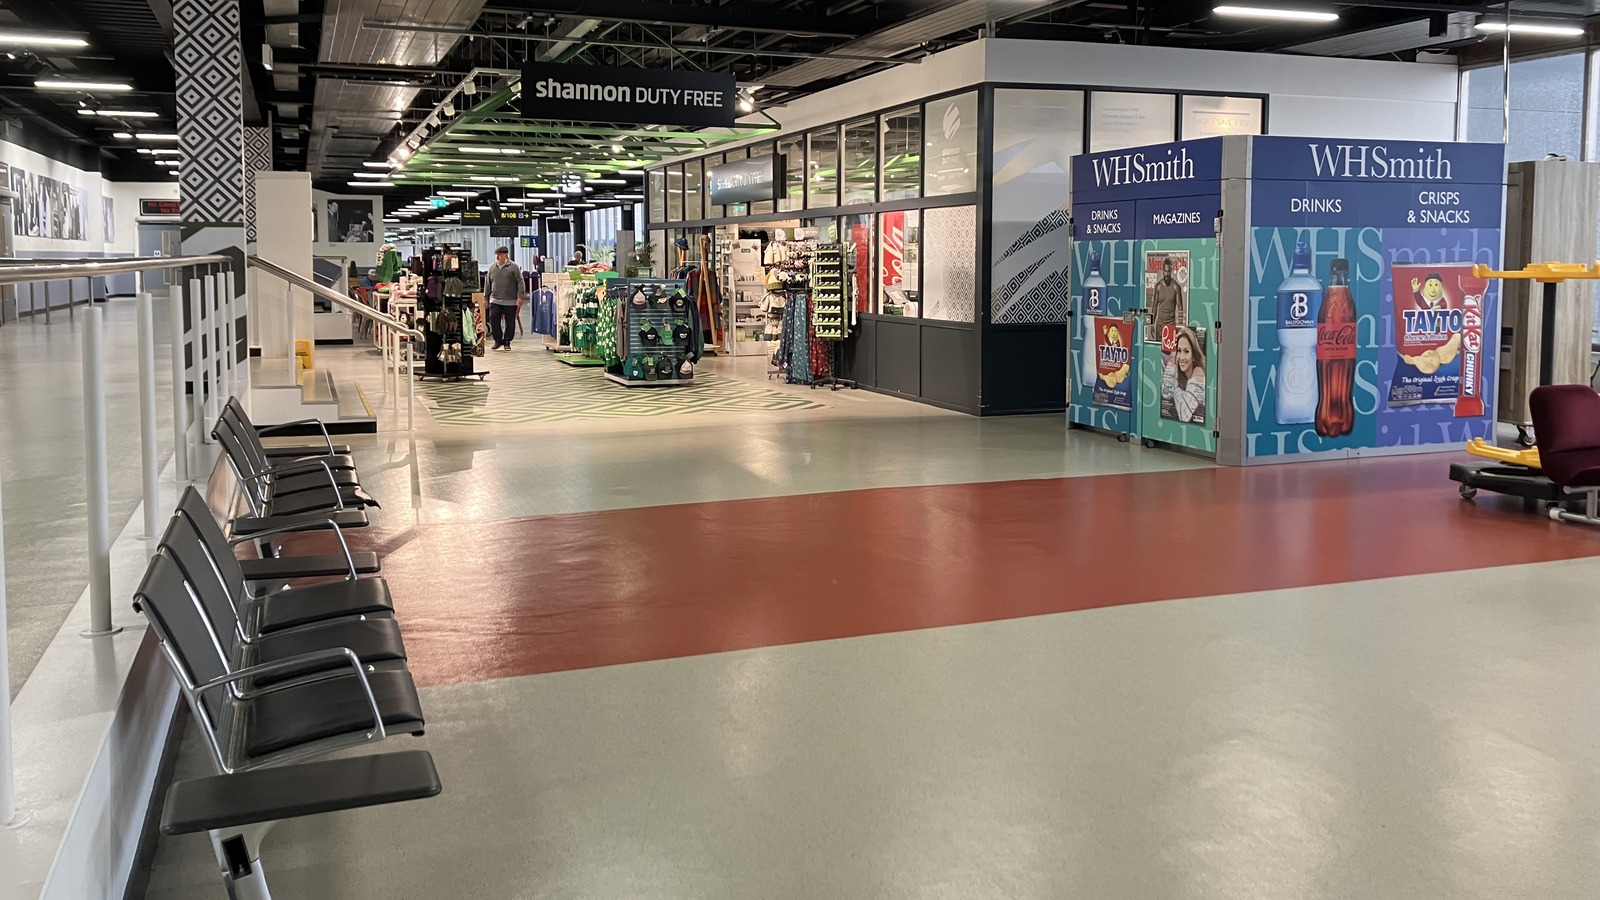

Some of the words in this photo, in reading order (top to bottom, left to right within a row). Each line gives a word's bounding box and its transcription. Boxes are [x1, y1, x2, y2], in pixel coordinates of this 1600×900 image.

[535, 78, 631, 103] shannon
[636, 87, 681, 105] DUTY
[683, 89, 723, 107] FREE
[1217, 118, 1232, 126] SAVE
[1092, 148, 1195, 187] WHSmith
[1308, 143, 1452, 180] WHSmith
[1290, 198, 1342, 213] DRINKS
[1418, 191, 1460, 205] CRISPS
[1091, 209, 1118, 221] DRINKS
[1153, 212, 1201, 225] MAGAZINES
[1407, 210, 1416, 223] &
[1420, 210, 1470, 223] SNACKS
[1086, 224, 1092, 234] &
[1093, 223, 1121, 234] SNACKS
[1403, 309, 1463, 334] TAYTO
[1161, 325, 1178, 349] Red
[1318, 325, 1355, 345] Coca-Cola
[1099, 345, 1128, 364] TAYTO
[1413, 376, 1433, 385] Original
[1465, 353, 1475, 396] CHUNKY
